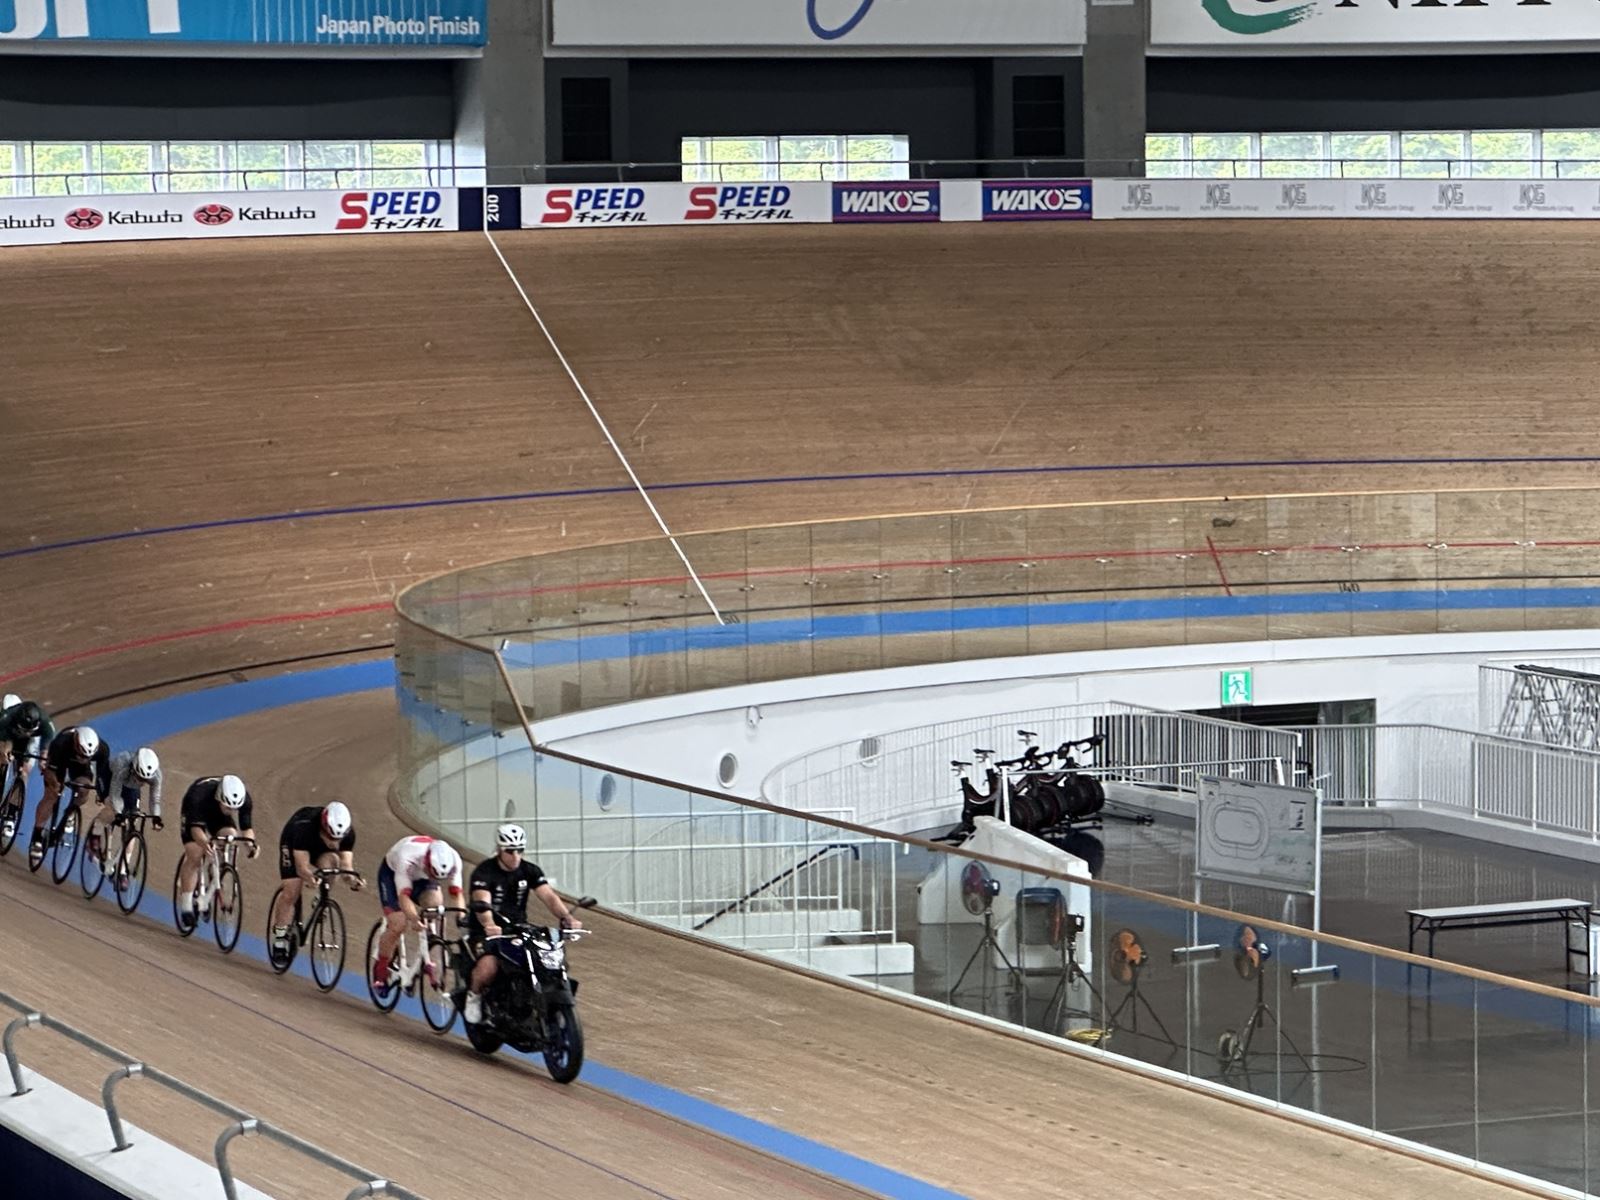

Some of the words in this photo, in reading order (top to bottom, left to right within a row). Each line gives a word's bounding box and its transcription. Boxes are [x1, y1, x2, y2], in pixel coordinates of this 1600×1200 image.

[316, 14, 370, 38] Japan
[372, 15, 425, 35] Photo
[428, 16, 480, 35] Finish
[335, 191, 441, 229] SPEED
[487, 194, 500, 223] 200
[541, 188, 645, 223] SPEED
[684, 185, 791, 220] SPEED
[0, 214, 55, 229] abuto
[108, 209, 183, 225] Kabuto
[238, 206, 316, 222] Kabuto
[575, 211, 648, 223] チャンネル
[719, 208, 793, 220] チャンネル
[370, 217, 444, 230] チャンネル
